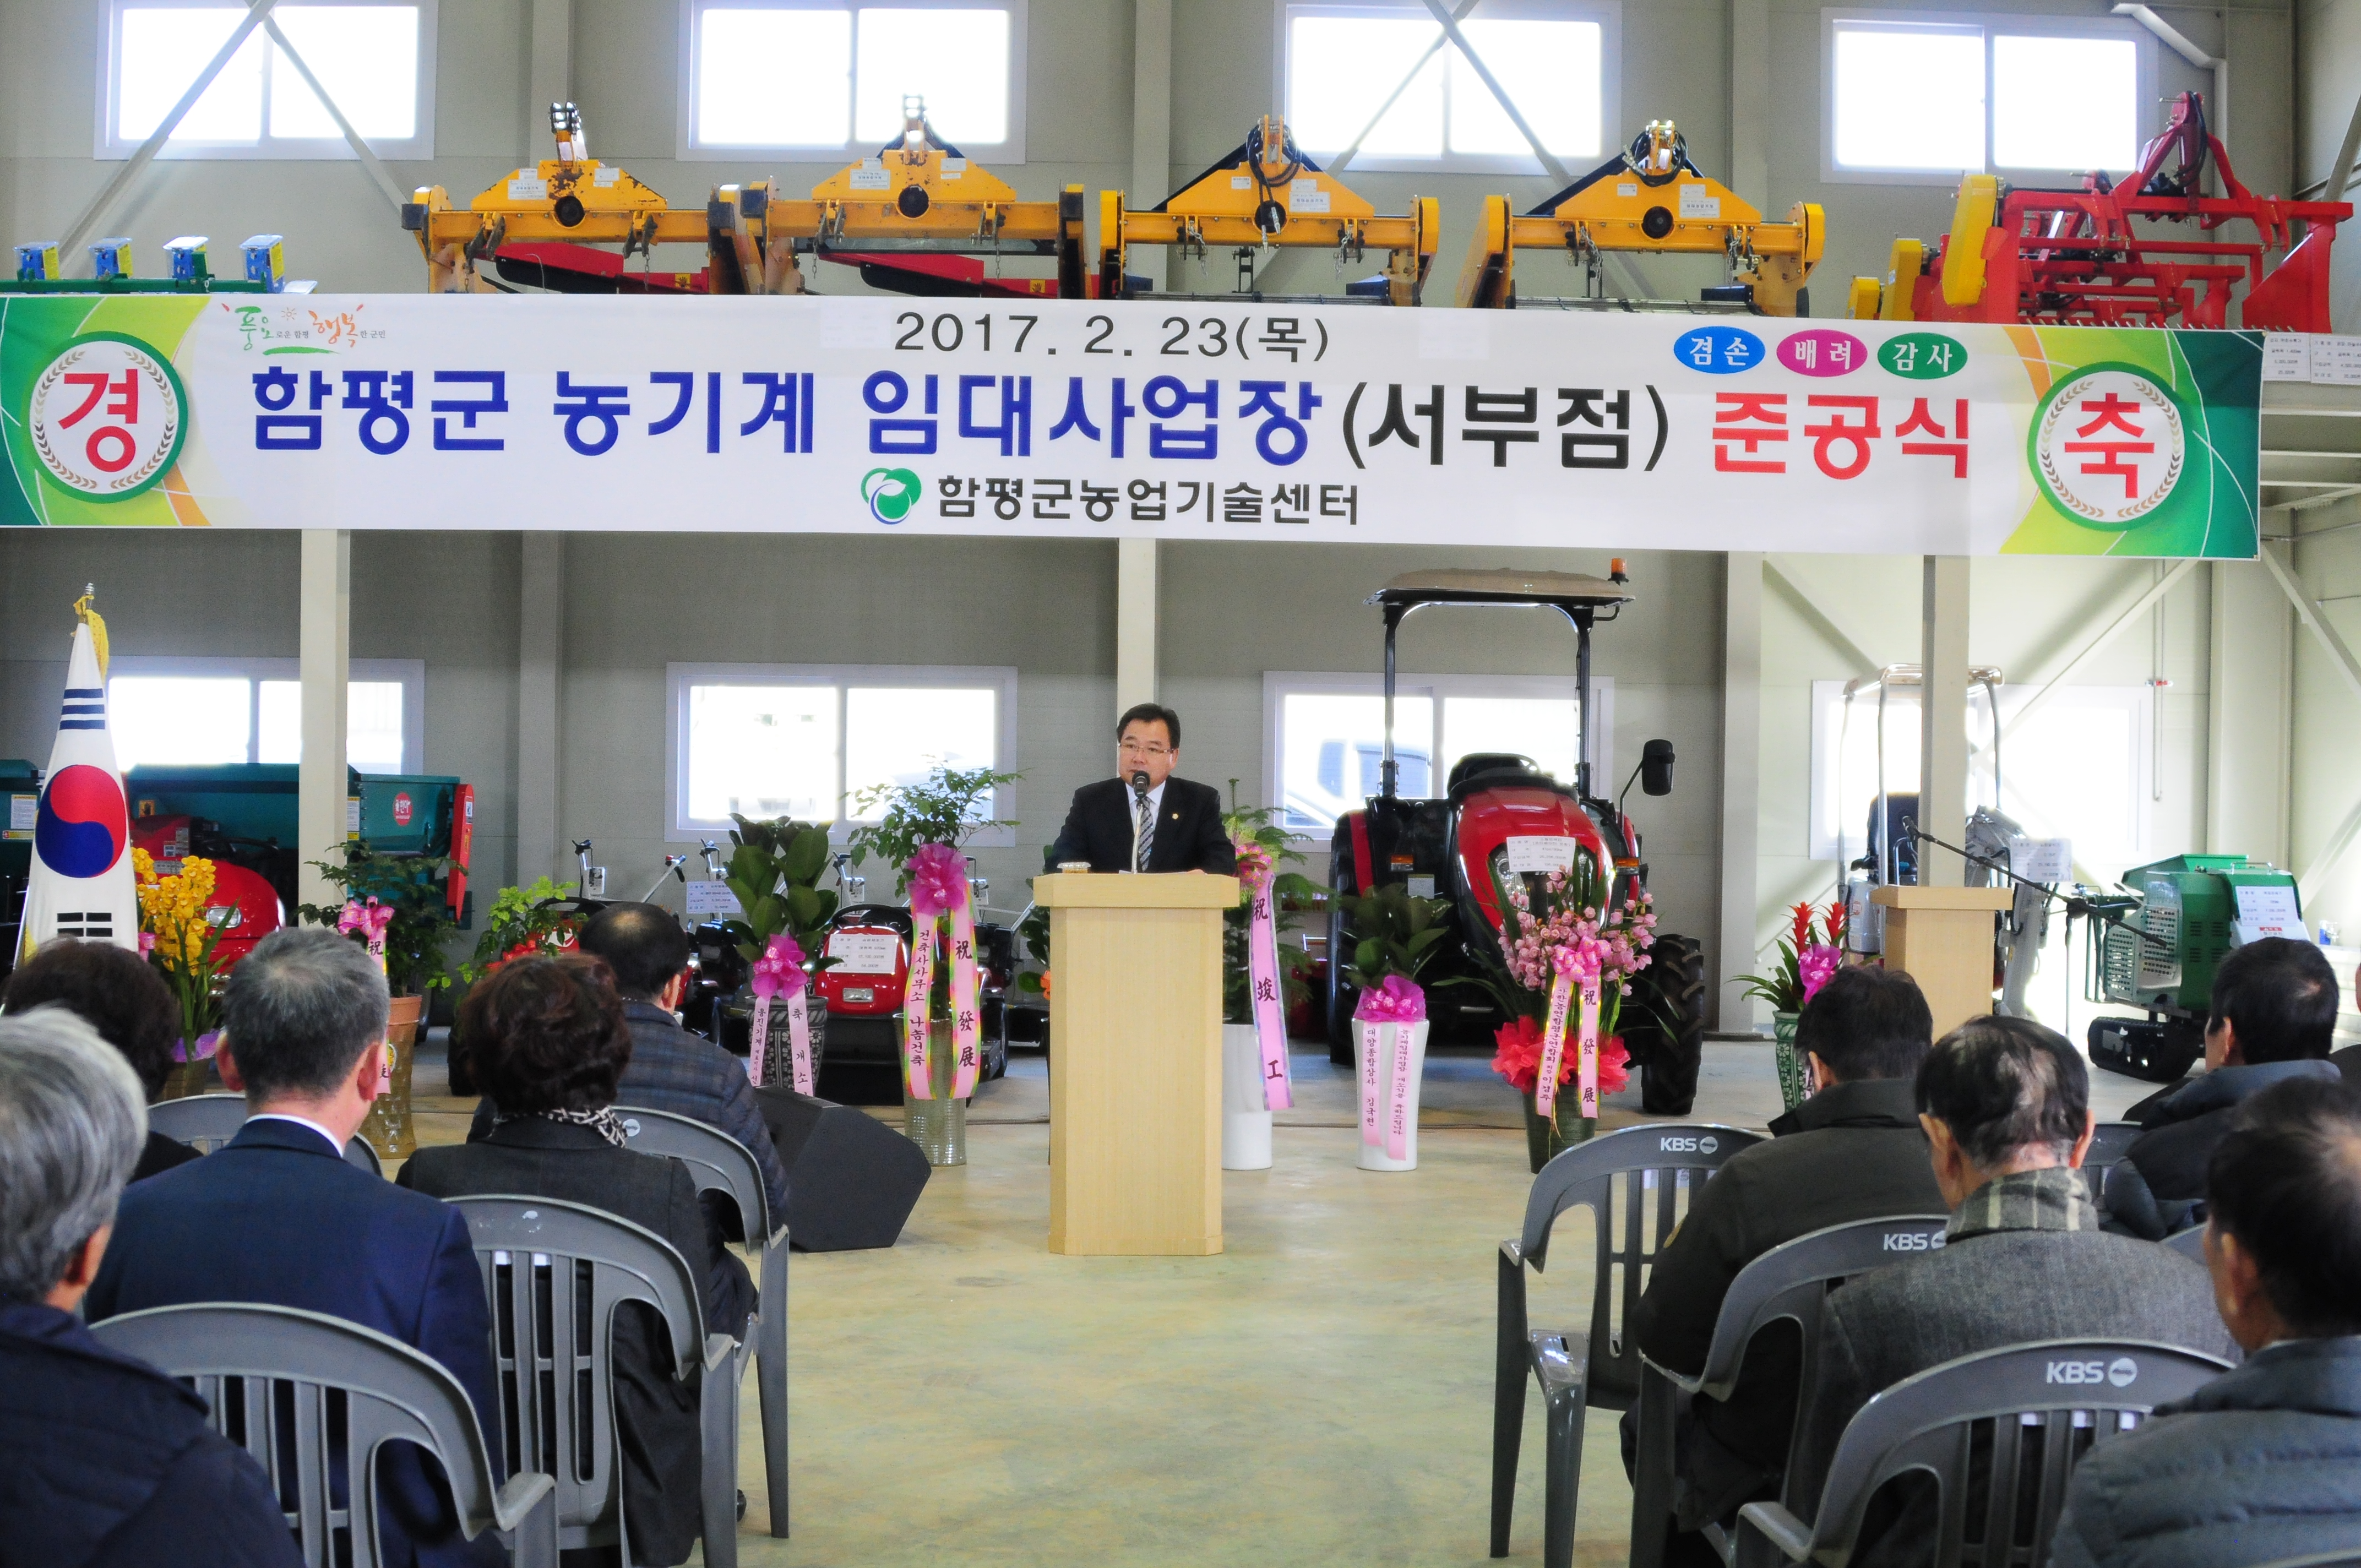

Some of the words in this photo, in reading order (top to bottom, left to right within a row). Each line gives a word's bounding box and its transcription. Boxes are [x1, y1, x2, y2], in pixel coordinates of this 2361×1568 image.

[294, 330, 309, 339] 함평
[369, 330, 386, 339] 군민
[895, 312, 1056, 356] 2017.
[1085, 315, 1132, 357] 2.
[1161, 317, 1328, 363] 23(목)
[1689, 337, 1750, 366] 겸손
[1795, 339, 1851, 369] 배려
[1892, 342, 1952, 373] 감사
[58, 368, 138, 473] 경
[252, 366, 508, 455] 함평군
[553, 371, 814, 456] 농기계
[1712, 392, 1968, 480] 준공식
[2064, 393, 2155, 498] 축
[938, 475, 1357, 525] 함평군농업기술센터
[910, 929, 930, 1003] 건축사사무소
[1367, 1027, 1377, 1087] 대양종합상사
[1660, 1137, 1697, 1152] KBS
[1883, 1233, 1928, 1251] KBS
[2046, 1361, 2104, 1384] KBS
